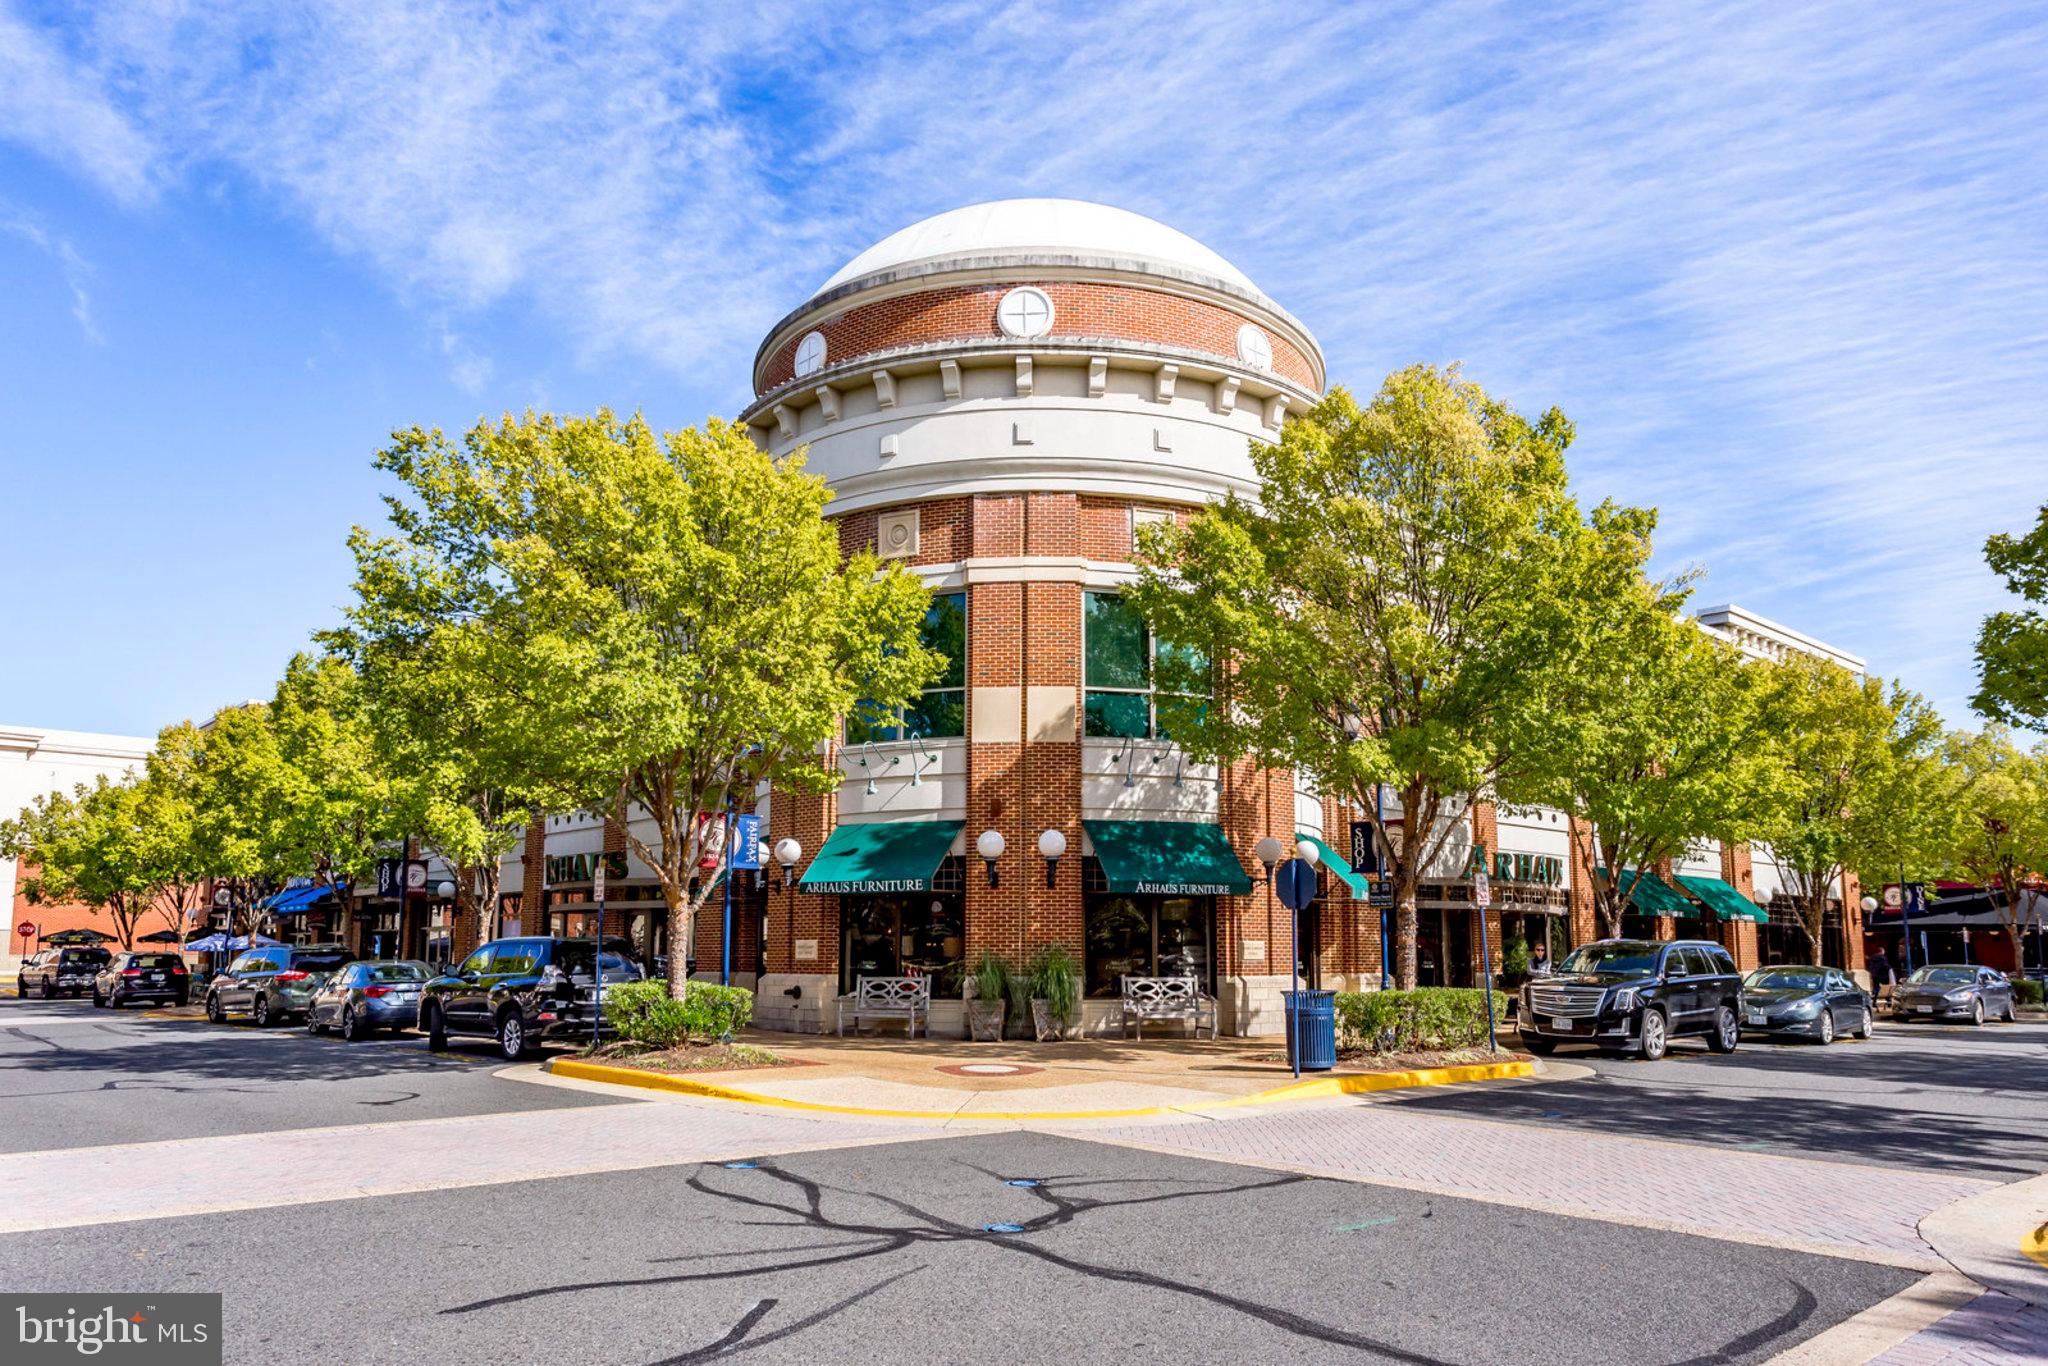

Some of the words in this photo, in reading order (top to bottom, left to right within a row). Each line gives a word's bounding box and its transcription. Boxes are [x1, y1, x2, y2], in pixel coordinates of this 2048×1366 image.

[749, 821, 758, 863] FAIRFAX
[1354, 828, 1365, 869] SHOP
[381, 862, 390, 893] SHOP
[805, 881, 849, 893] ARHAUS
[852, 879, 924, 893] FURNITURE
[1135, 881, 1178, 894] ARHAUS
[1179, 884, 1231, 894] FURNITURE
